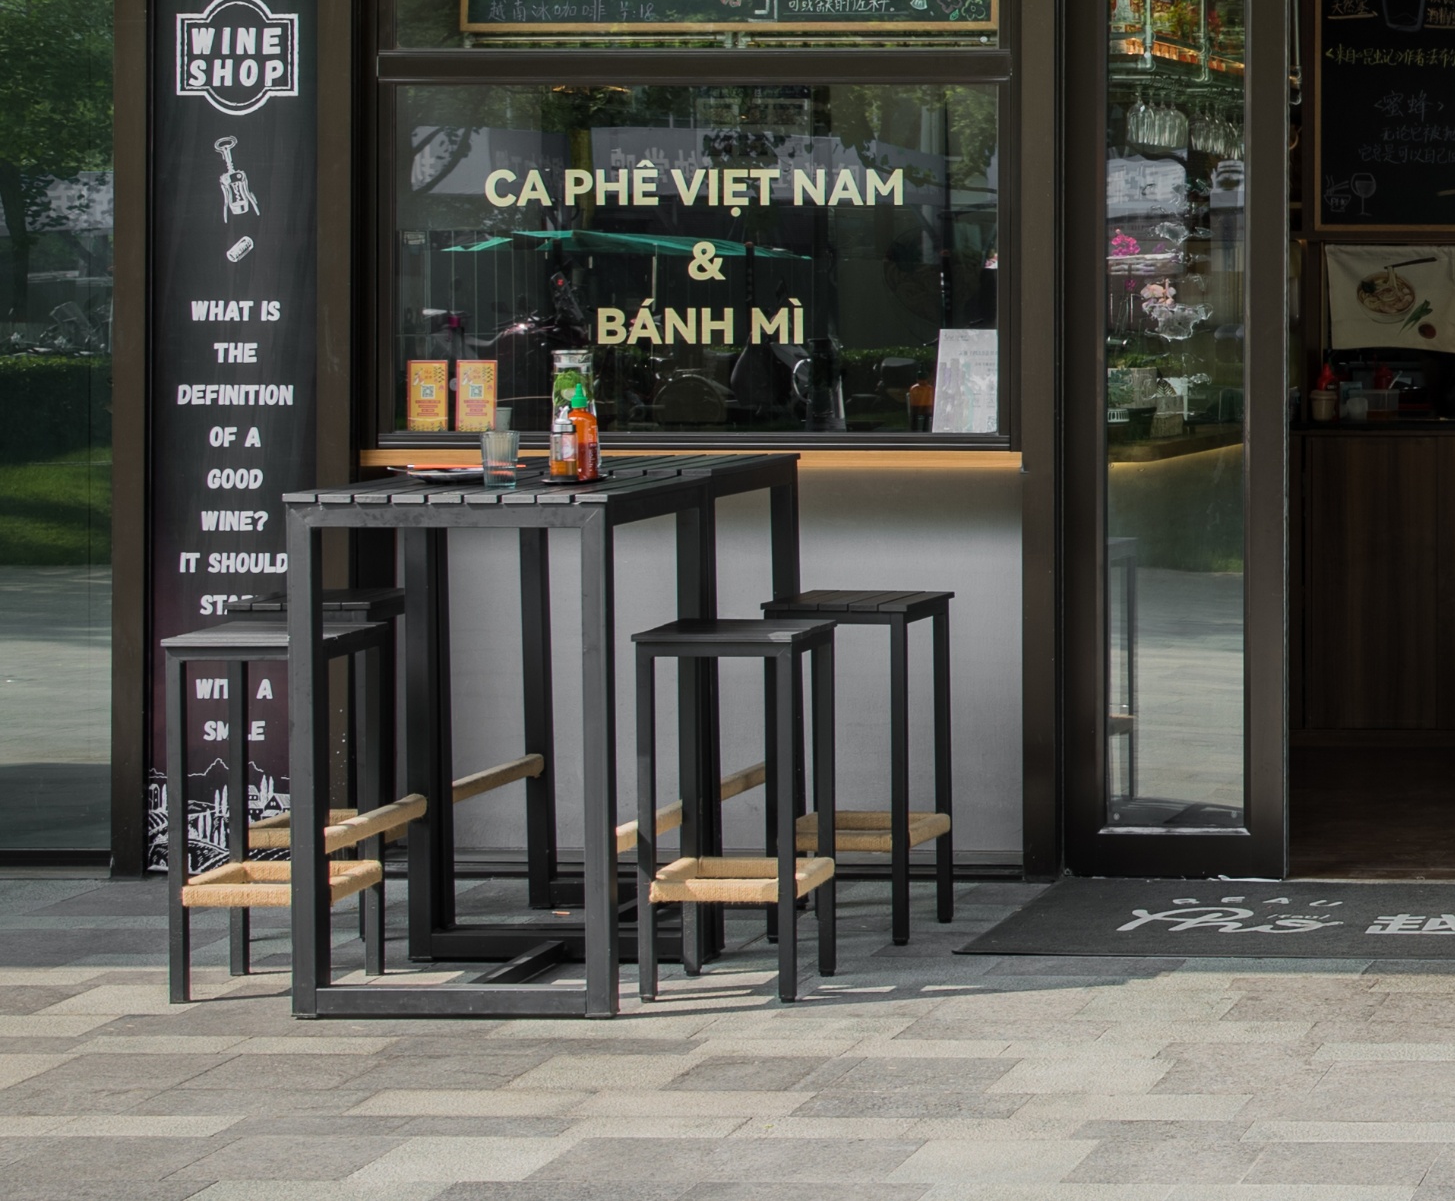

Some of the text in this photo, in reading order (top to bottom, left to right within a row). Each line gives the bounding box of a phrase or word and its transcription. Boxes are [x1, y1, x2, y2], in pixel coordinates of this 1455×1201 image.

[488, 0, 606, 21] 越南冰咖啡
[191, 26, 282, 56] WINE
[188, 58, 285, 87] SHOP
[485, 169, 552, 207] CA
[565, 160, 659, 206] PHÊ
[794, 169, 904, 206] NAM
[688, 241, 726, 281] &
[191, 300, 281, 322] WHAT IS
[598, 297, 804, 344] BÁNH MÌ
[213, 342, 258, 363] THE
[177, 384, 294, 405] DEFINITION
[209, 426, 261, 448] OF A
[207, 468, 263, 489] GOOD
[201, 510, 269, 532] WINE?
[179, 552, 288, 574] IT SHOULD
[196, 679, 273, 699] WIT A
[203, 720, 266, 741] SME
[1173, 895, 1343, 907] BEAU
